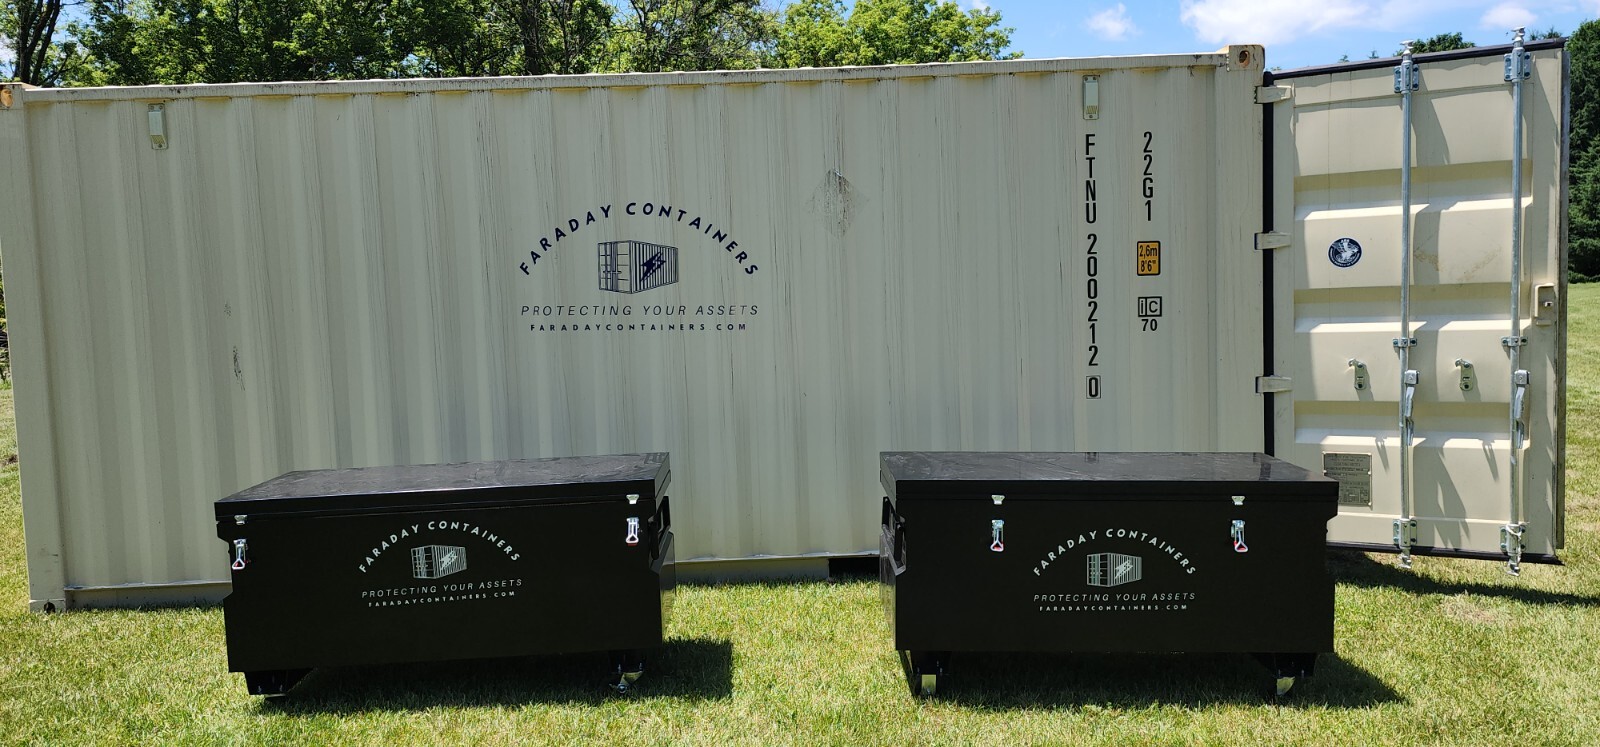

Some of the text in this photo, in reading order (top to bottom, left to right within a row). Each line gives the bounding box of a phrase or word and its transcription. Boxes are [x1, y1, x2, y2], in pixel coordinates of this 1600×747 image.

[1142, 131, 1153, 221] 22G1
[519, 202, 759, 275] FARADAY CONTAINERS
[1139, 245, 1157, 259] 2,6m
[1085, 133, 1098, 397] FTNU 200212 0
[521, 304, 759, 316] PROTECTING YOUR ASSETS
[530, 323, 747, 331] FARADAYCONTAINERS.COM
[1141, 318, 1158, 331] 70
[358, 520, 521, 573] FARADAY CONTAINERS
[1033, 528, 1197, 576] FARADAY CONTAINERS
[361, 578, 523, 599] PROTECTING YOUR ASSETS
[1033, 592, 1196, 602] PROTECTING YOUR ASSETS
